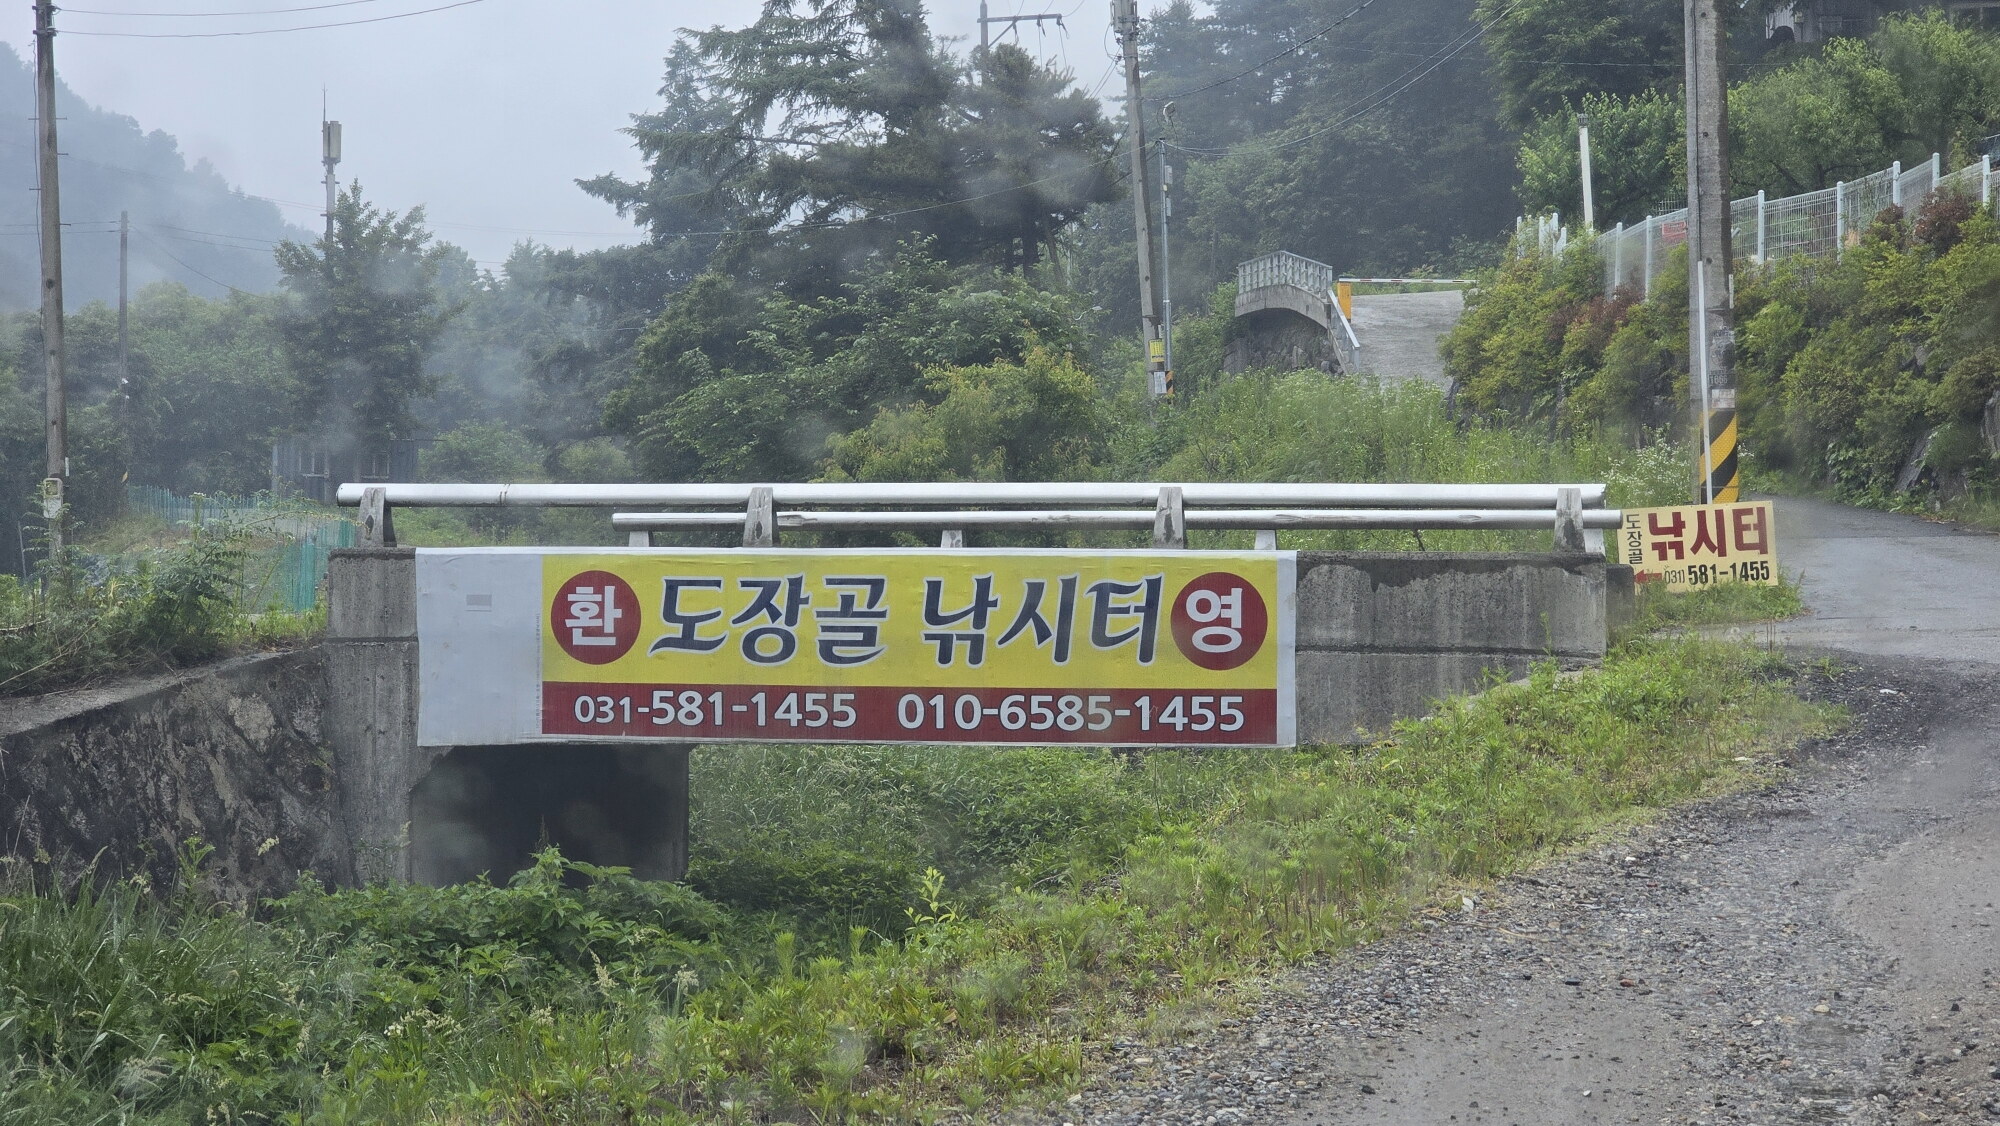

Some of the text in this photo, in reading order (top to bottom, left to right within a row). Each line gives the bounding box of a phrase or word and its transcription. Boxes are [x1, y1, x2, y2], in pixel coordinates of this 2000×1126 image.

[1626, 513, 1643, 565] 도장골
[1648, 506, 1769, 561] 낚시터
[1688, 560, 1771, 585] 581-1455
[564, 572, 1243, 668] 환 도장골 낚시터 영
[574, 690, 1245, 732] 031-581-1455 010-6585-1455
